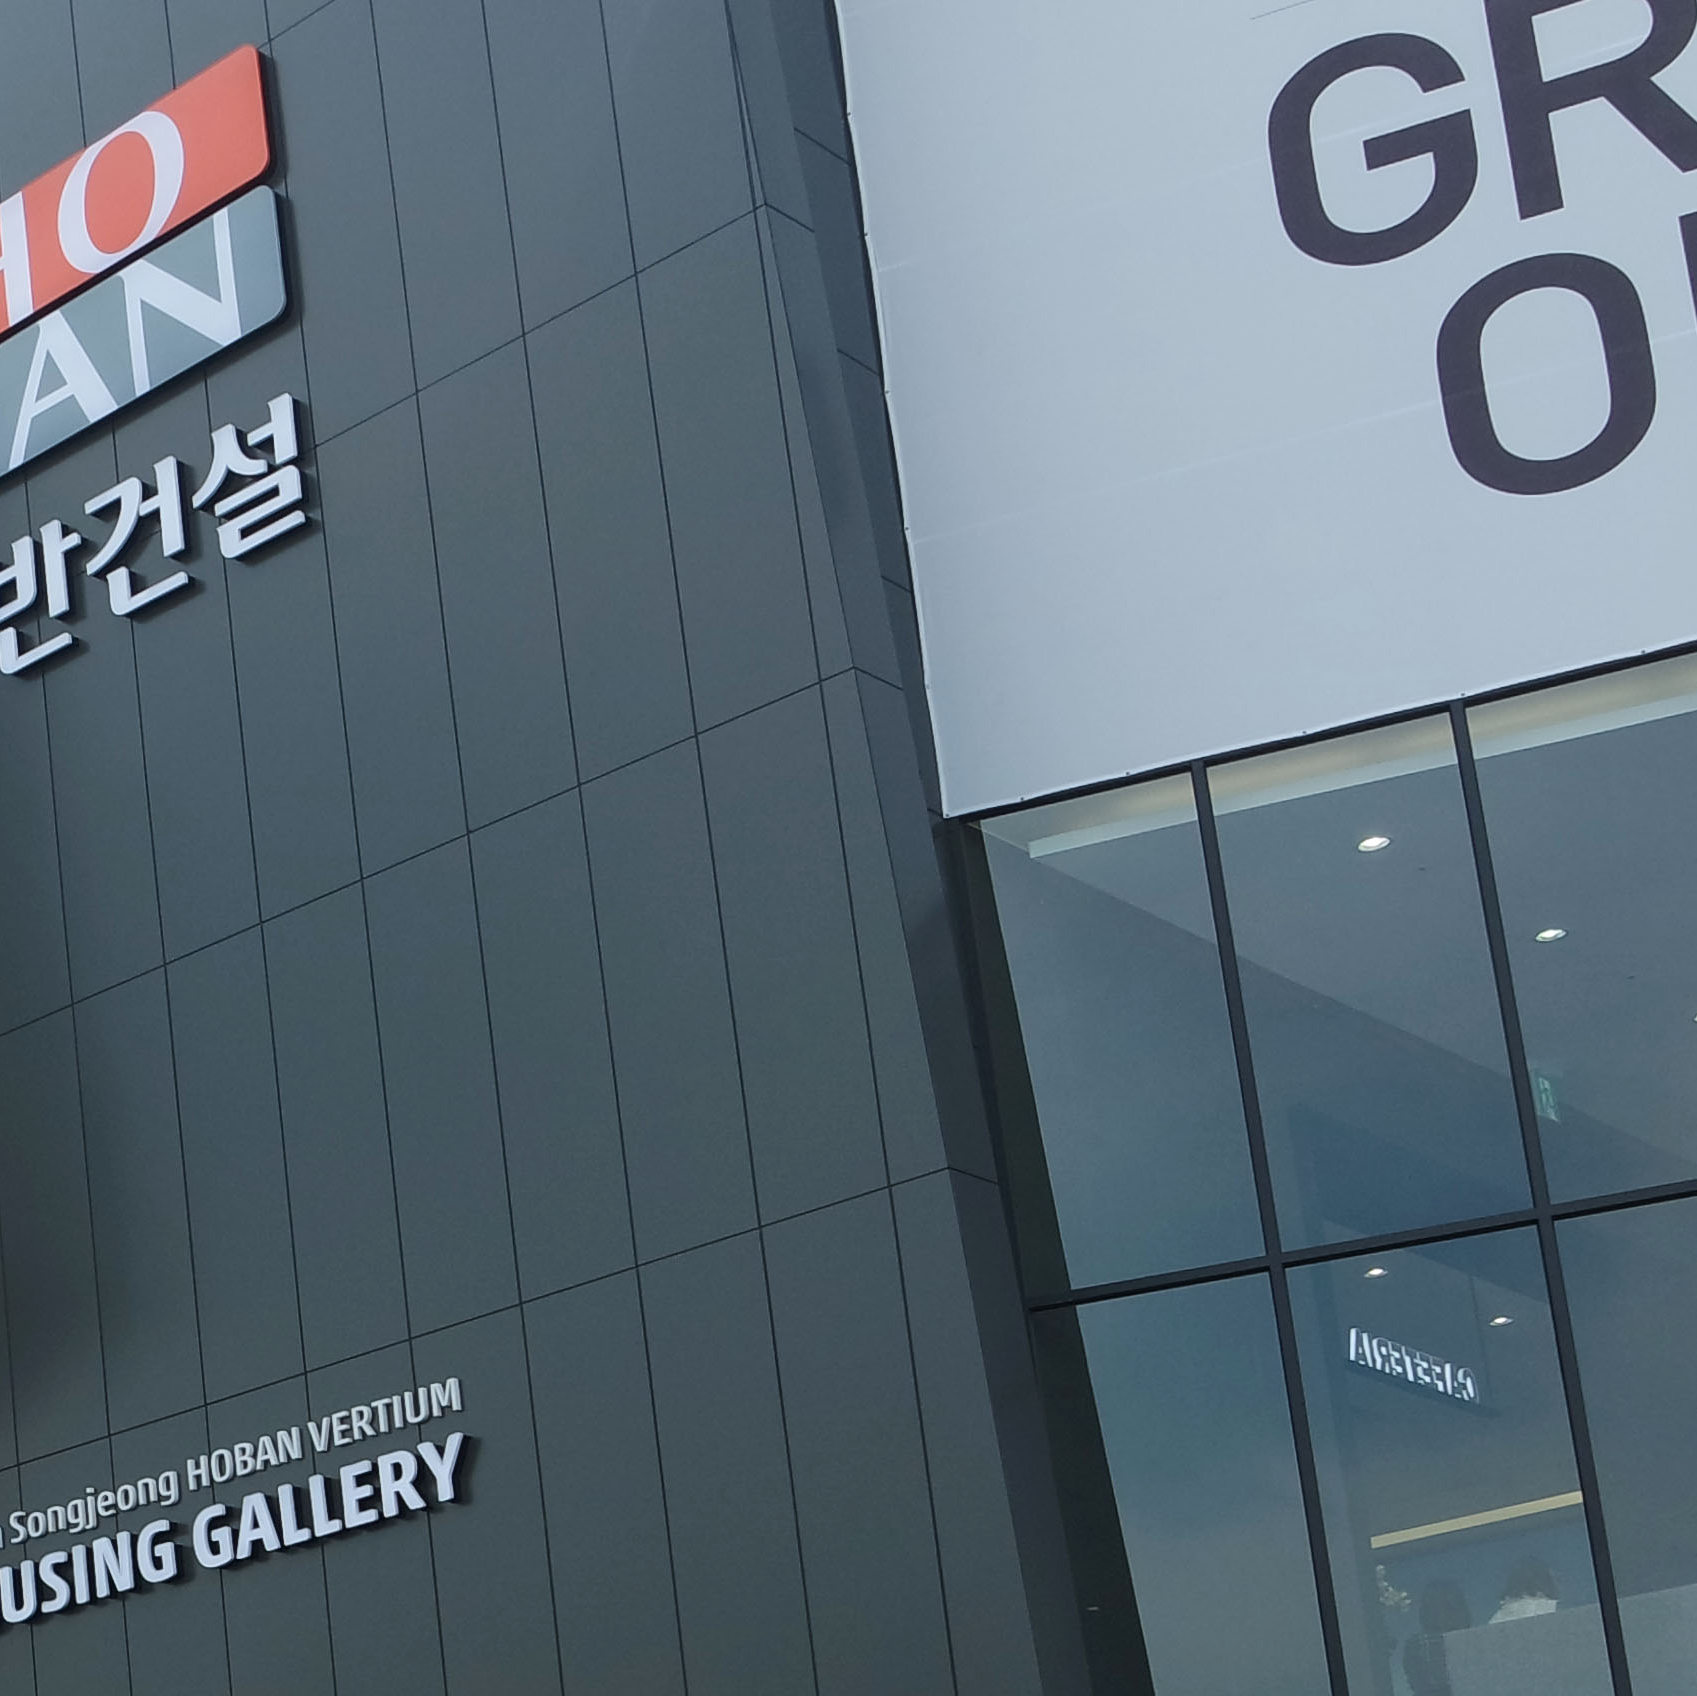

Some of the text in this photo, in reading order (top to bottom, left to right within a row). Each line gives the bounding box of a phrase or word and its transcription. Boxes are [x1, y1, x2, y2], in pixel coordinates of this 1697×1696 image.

[1436, 209, 1697, 496] O
[9, 1470, 180, 1545] Songjeong
[186, 1426, 304, 1490] HOBAN
[306, 1378, 463, 1453] VERTIUM
[192, 1431, 467, 1569] GALLERY
